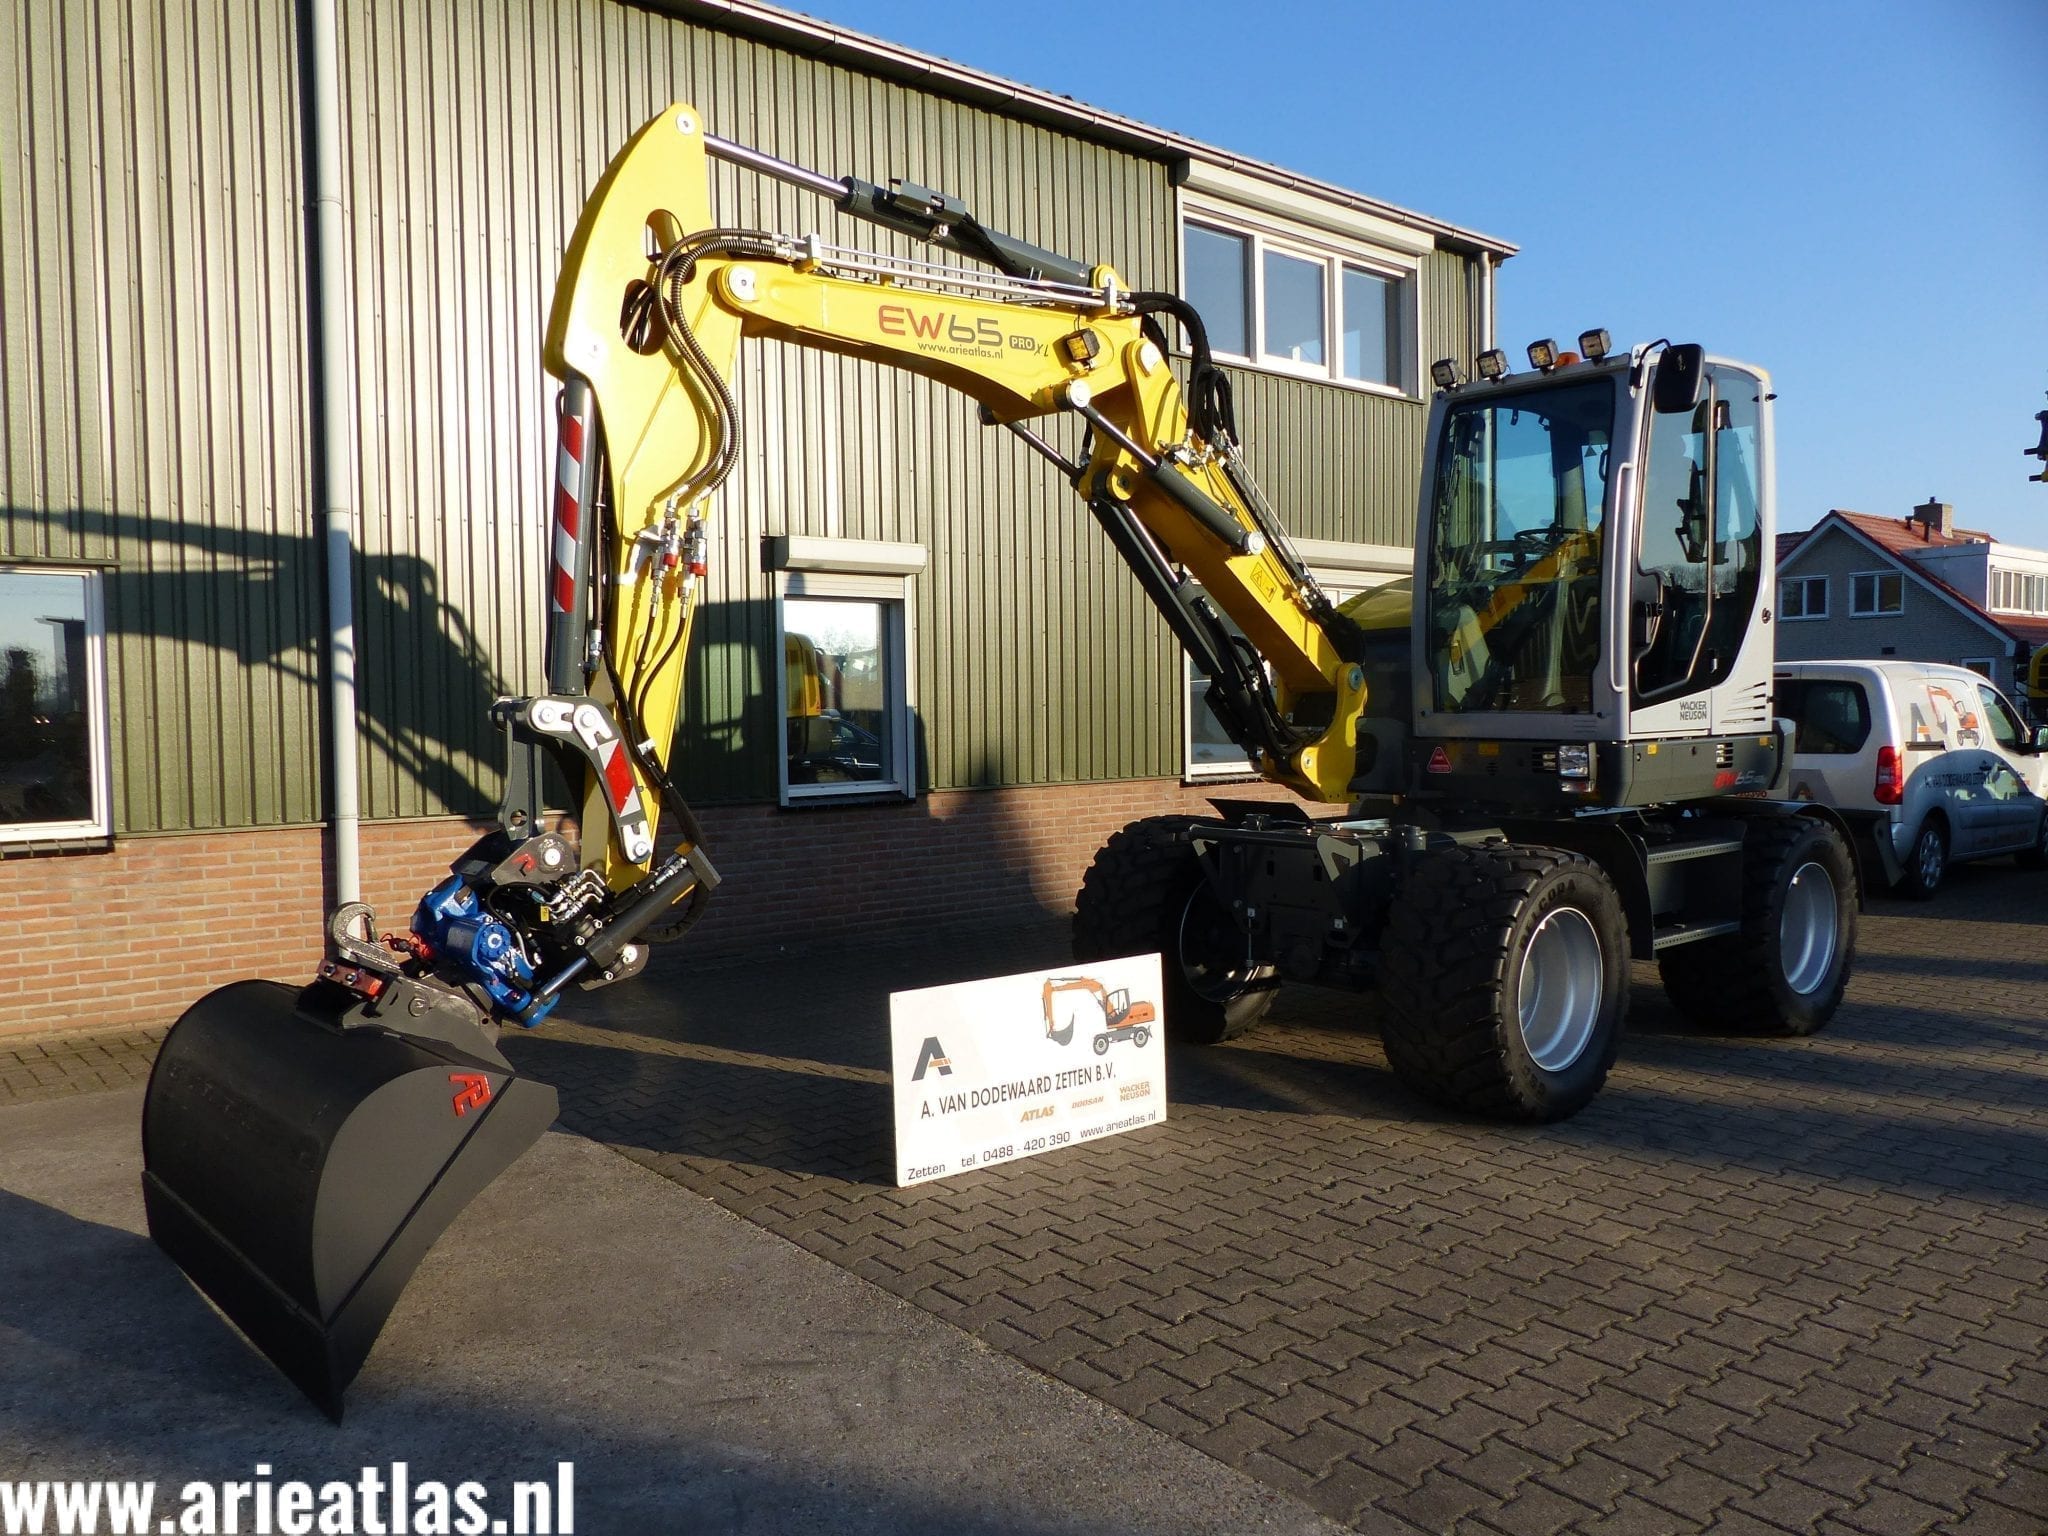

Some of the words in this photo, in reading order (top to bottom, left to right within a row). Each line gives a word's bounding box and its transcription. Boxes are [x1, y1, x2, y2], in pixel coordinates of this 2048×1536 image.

[878, 305, 1003, 347] EW65
[1010, 336, 1034, 350] PRO
[918, 342, 1003, 359] www.arieatlas.nl
[1680, 700, 1707, 711] WACKER
[1680, 711, 1707, 720] NEUSON
[921, 1101, 935, 1119] A.
[939, 1093, 967, 1115] VAN
[971, 1076, 1051, 1108] DODEWAARD
[1055, 1067, 1092, 1091] ZETTEN
[1096, 1062, 1116, 1081] B.V.
[1119, 1081, 1150, 1093] WACKER
[1119, 1088, 1150, 1102] NEUSON
[1020, 1105, 1055, 1123] ATLAS
[907, 1164, 946, 1181] Zetten
[983, 1145, 1014, 1162] 0488
[1023, 1137, 1046, 1152] 420
[1049, 1131, 1071, 1146] 390
